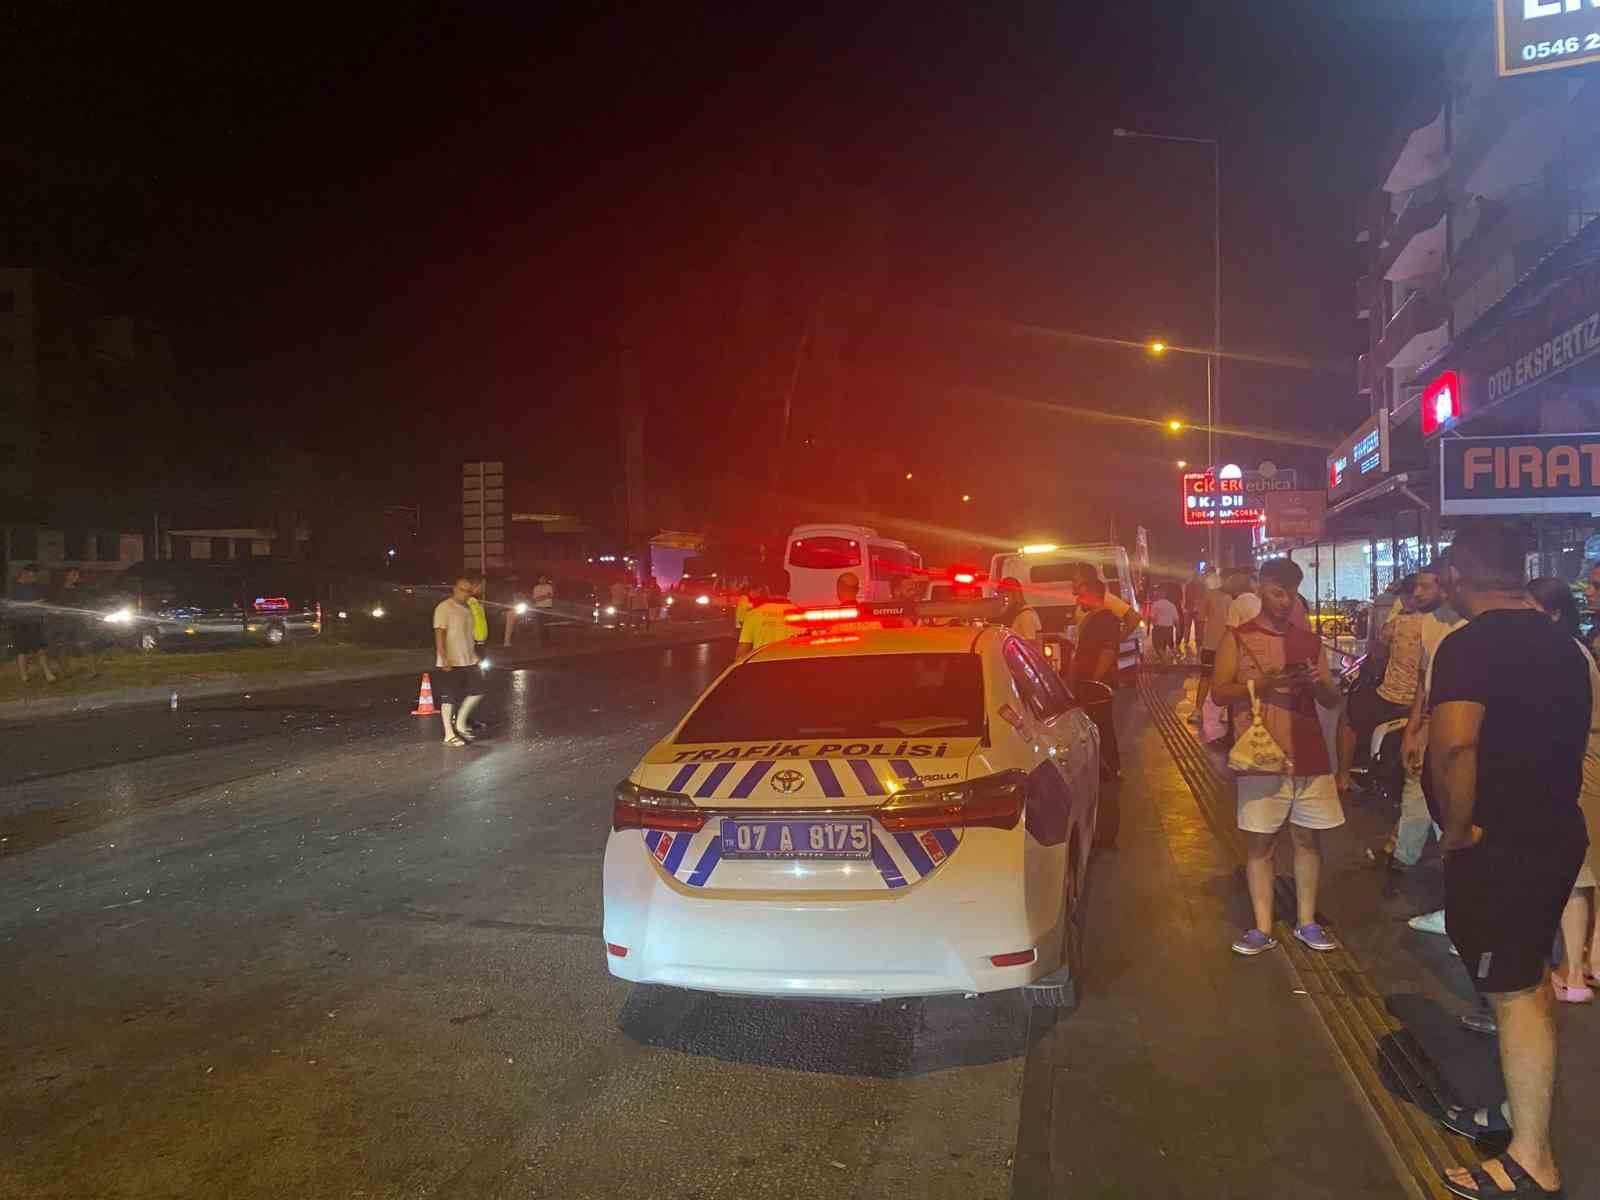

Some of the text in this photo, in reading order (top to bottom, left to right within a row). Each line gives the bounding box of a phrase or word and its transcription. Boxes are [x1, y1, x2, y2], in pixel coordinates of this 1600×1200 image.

[1522, 37, 1579, 60] 0546
[1488, 365, 1513, 400] OTO
[672, 740, 948, 763] TRAFİK POLİSİ
[737, 823, 866, 851] 07 A 8175
